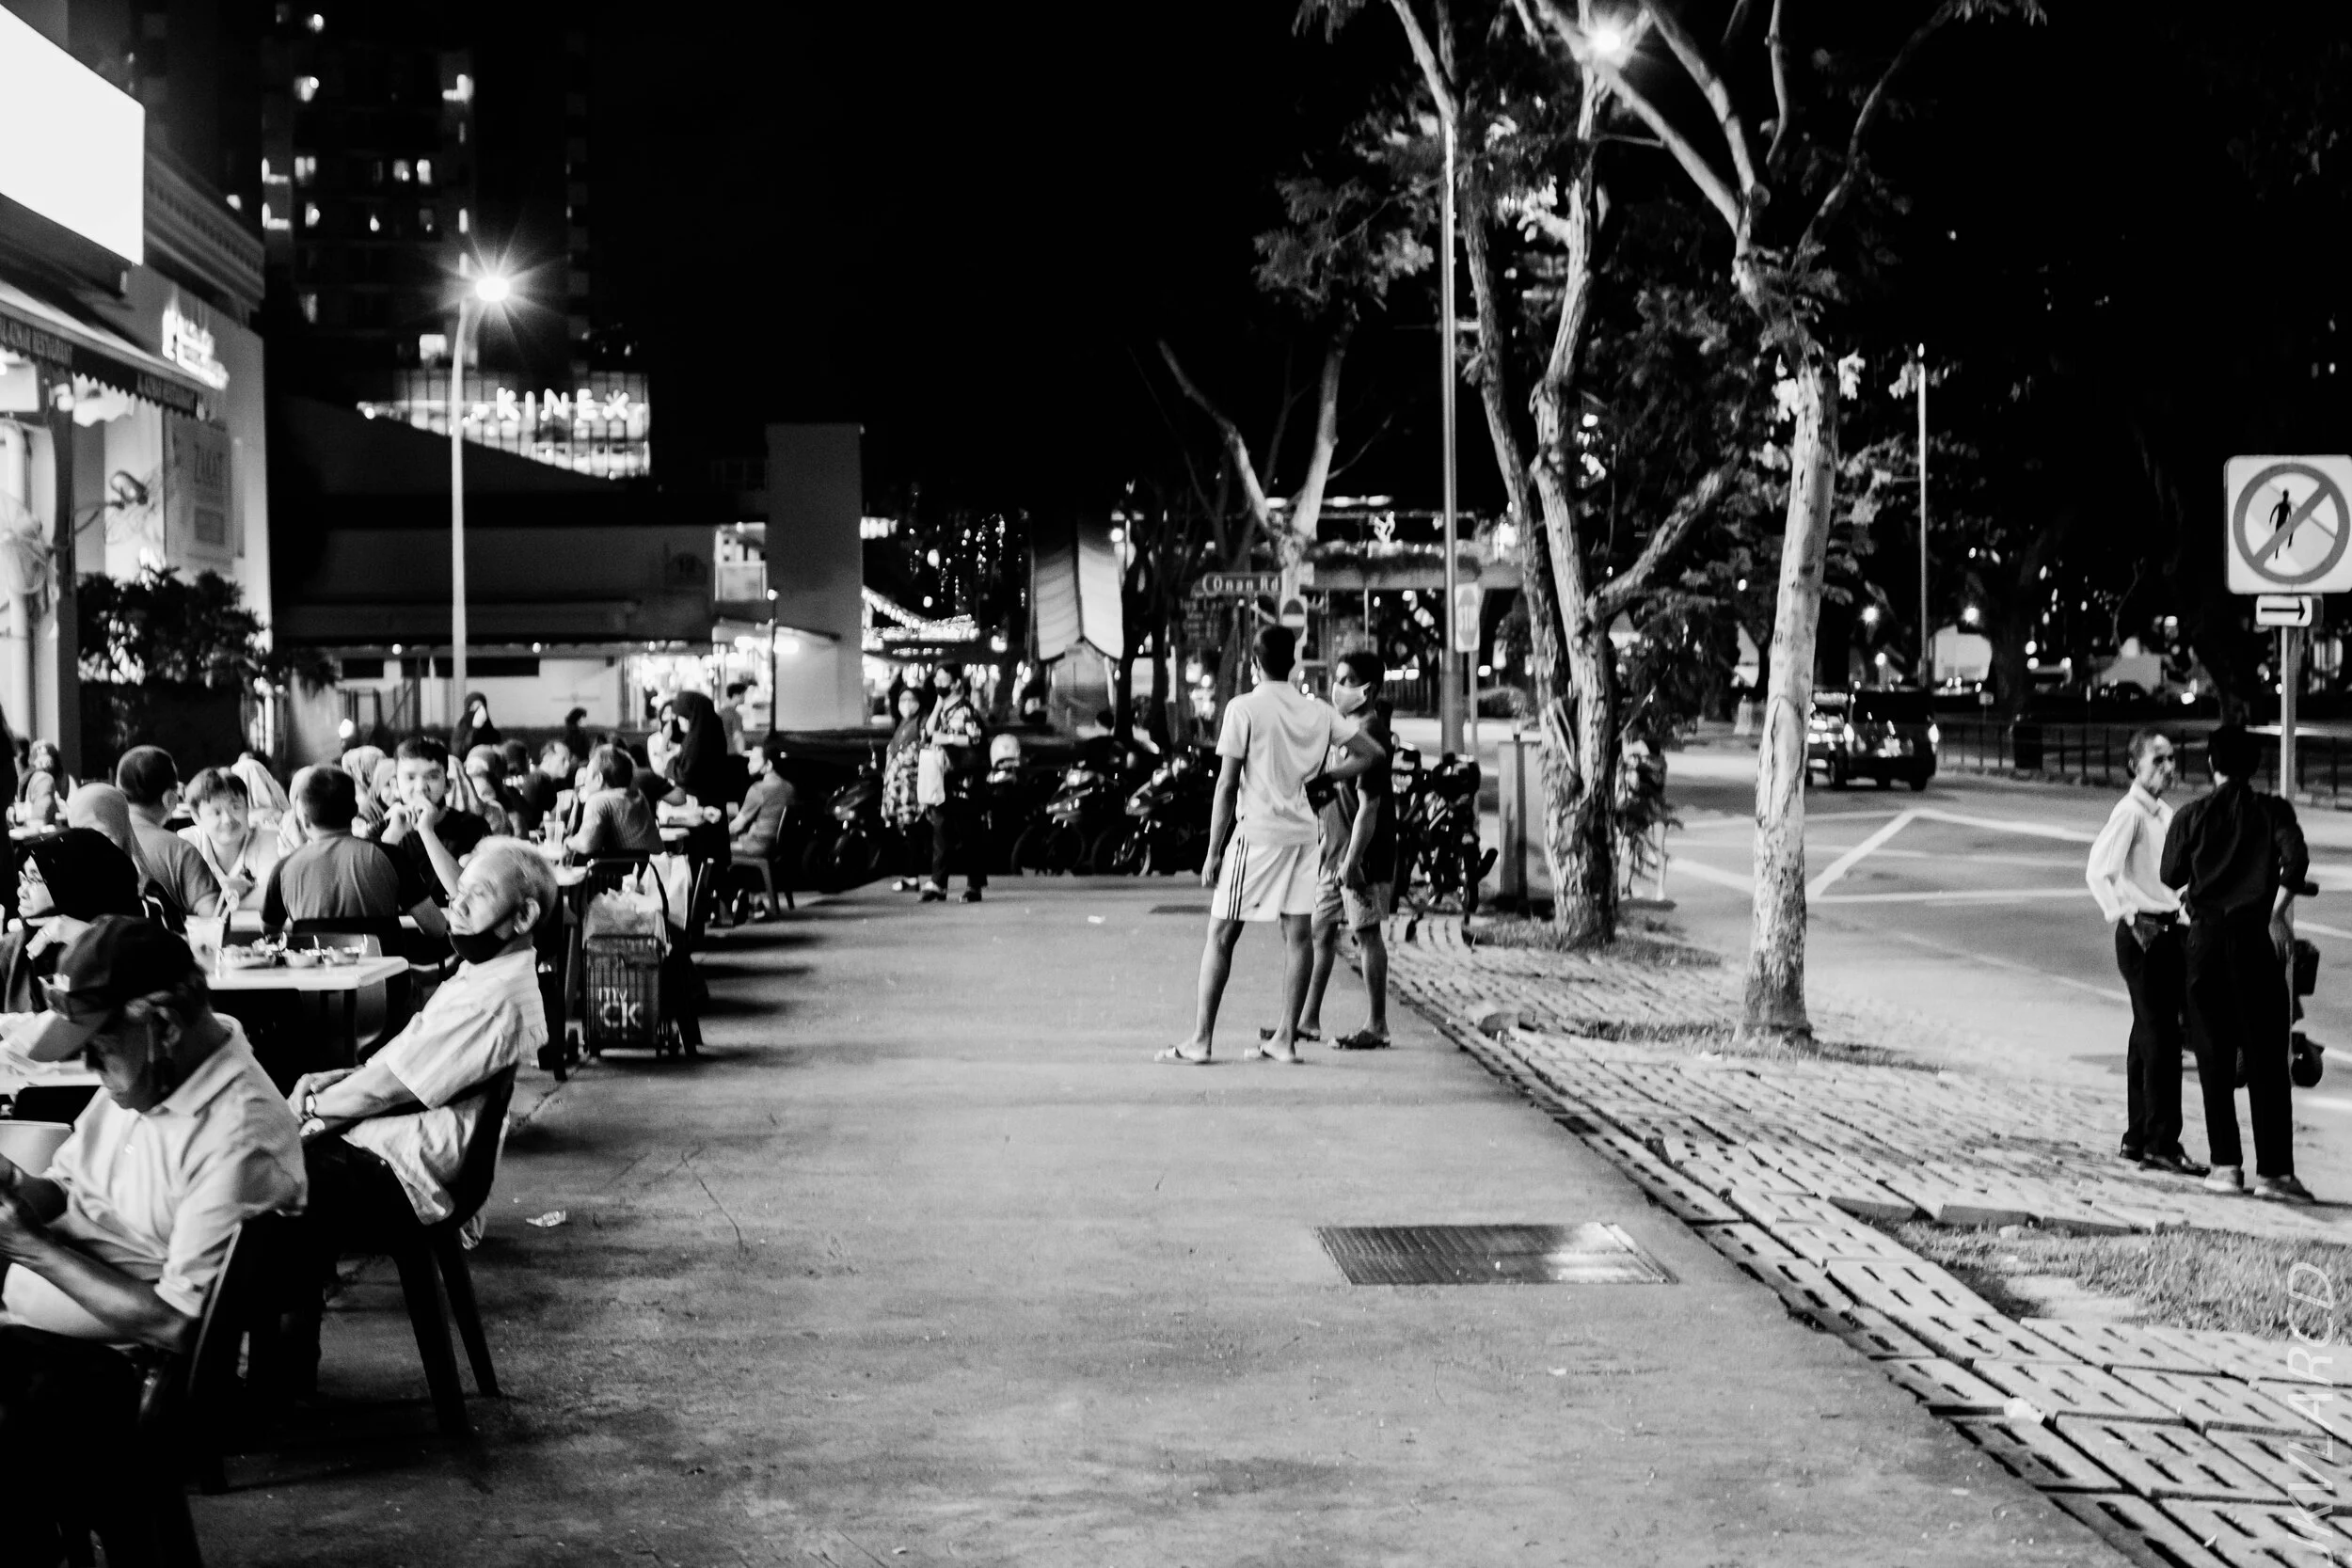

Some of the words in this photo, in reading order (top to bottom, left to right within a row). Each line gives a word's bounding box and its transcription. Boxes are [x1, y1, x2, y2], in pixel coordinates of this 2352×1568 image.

[496, 387, 630, 421] KINEX
[1213, 575, 1254, 593] Onan
[1260, 575, 1279, 593] Rd
